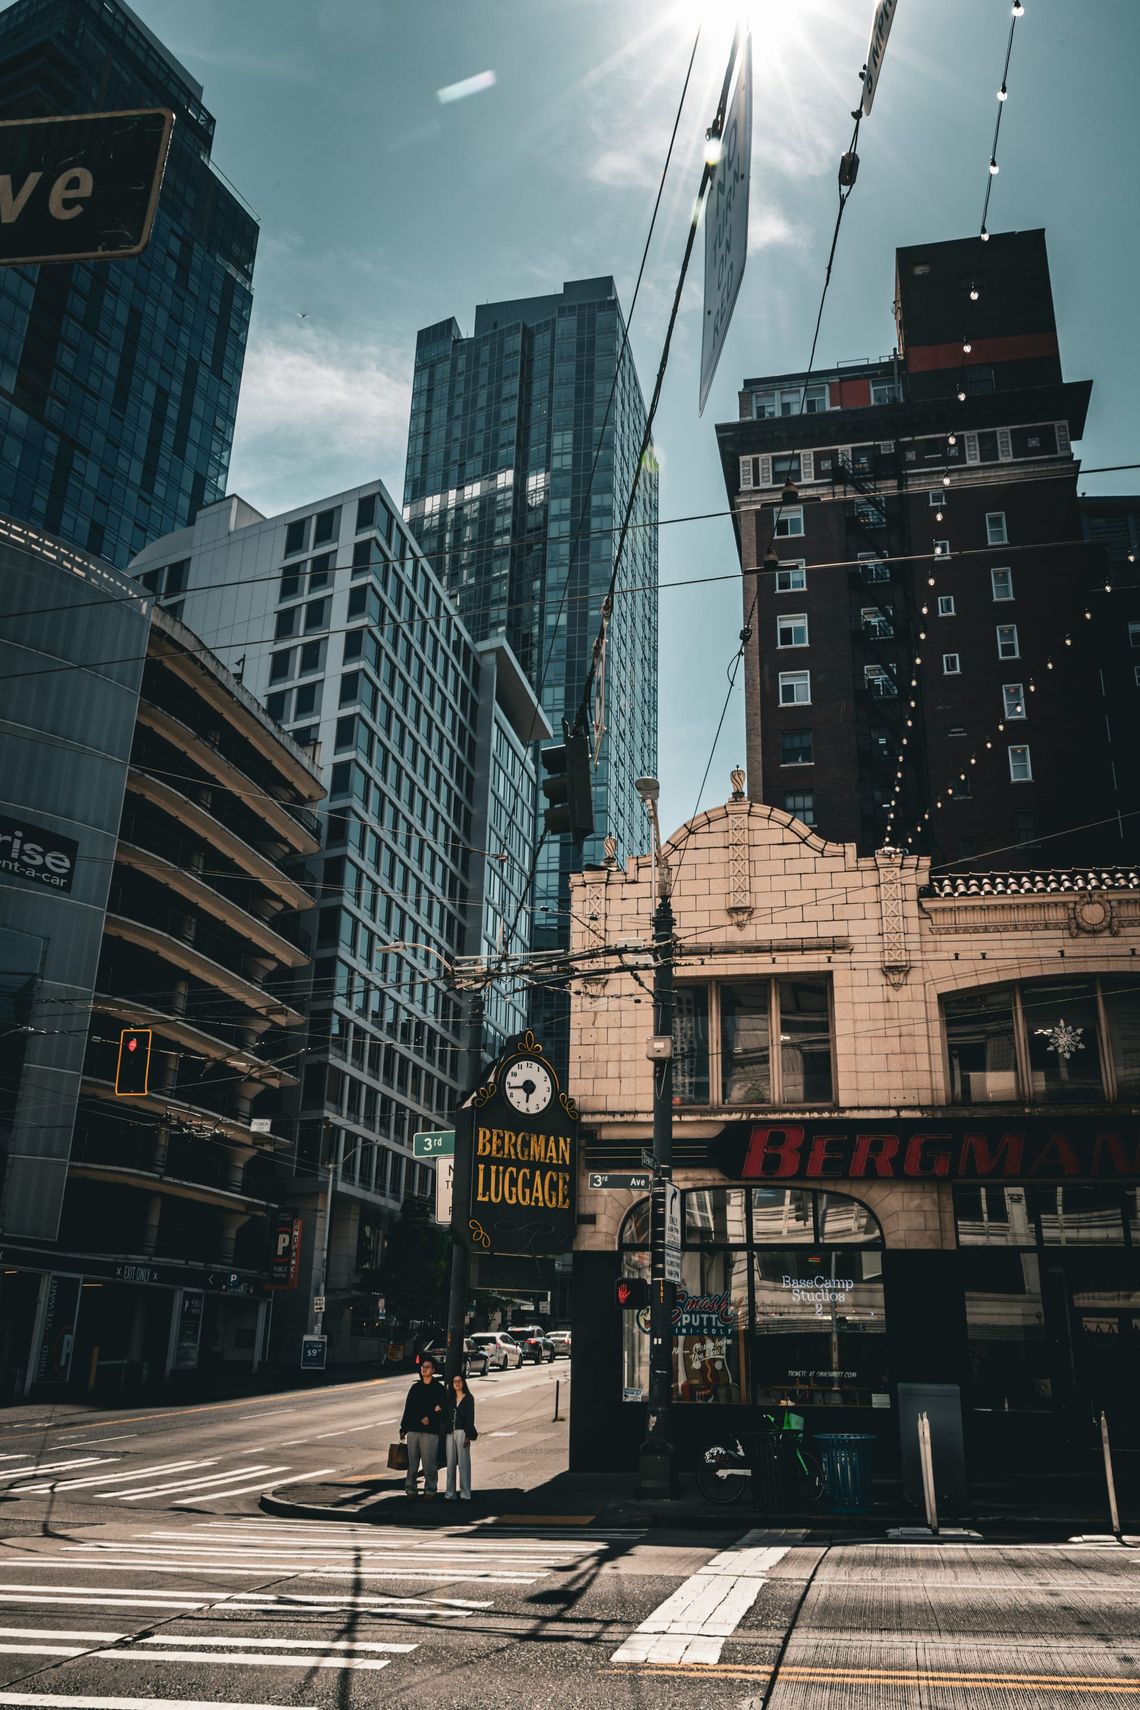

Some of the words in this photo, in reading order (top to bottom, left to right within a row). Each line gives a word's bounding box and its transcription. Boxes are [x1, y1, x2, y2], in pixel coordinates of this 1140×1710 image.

[0, 858, 68, 887] nt-a-car
[535, 1103, 540, 1111] 5
[423, 1137, 442, 1152] 3rd
[477, 1127, 571, 1166] BERGMAN
[742, 1124, 1140, 1179] BERGMAN
[476, 1163, 570, 1209] LUGGAGE
[593, 1174, 609, 1188] 3rd
[630, 1177, 646, 1187] Ave
[276, 1233, 290, 1256] P
[136, 1267, 152, 1281] ONLY
[230, 1274, 238, 1285] P
[782, 1275, 854, 1292] BaseCamp
[792, 1289, 846, 1302] Studios
[672, 1290, 736, 1325] Smash
[815, 1303, 824, 1316] 2
[677, 1314, 726, 1327] PUTT
